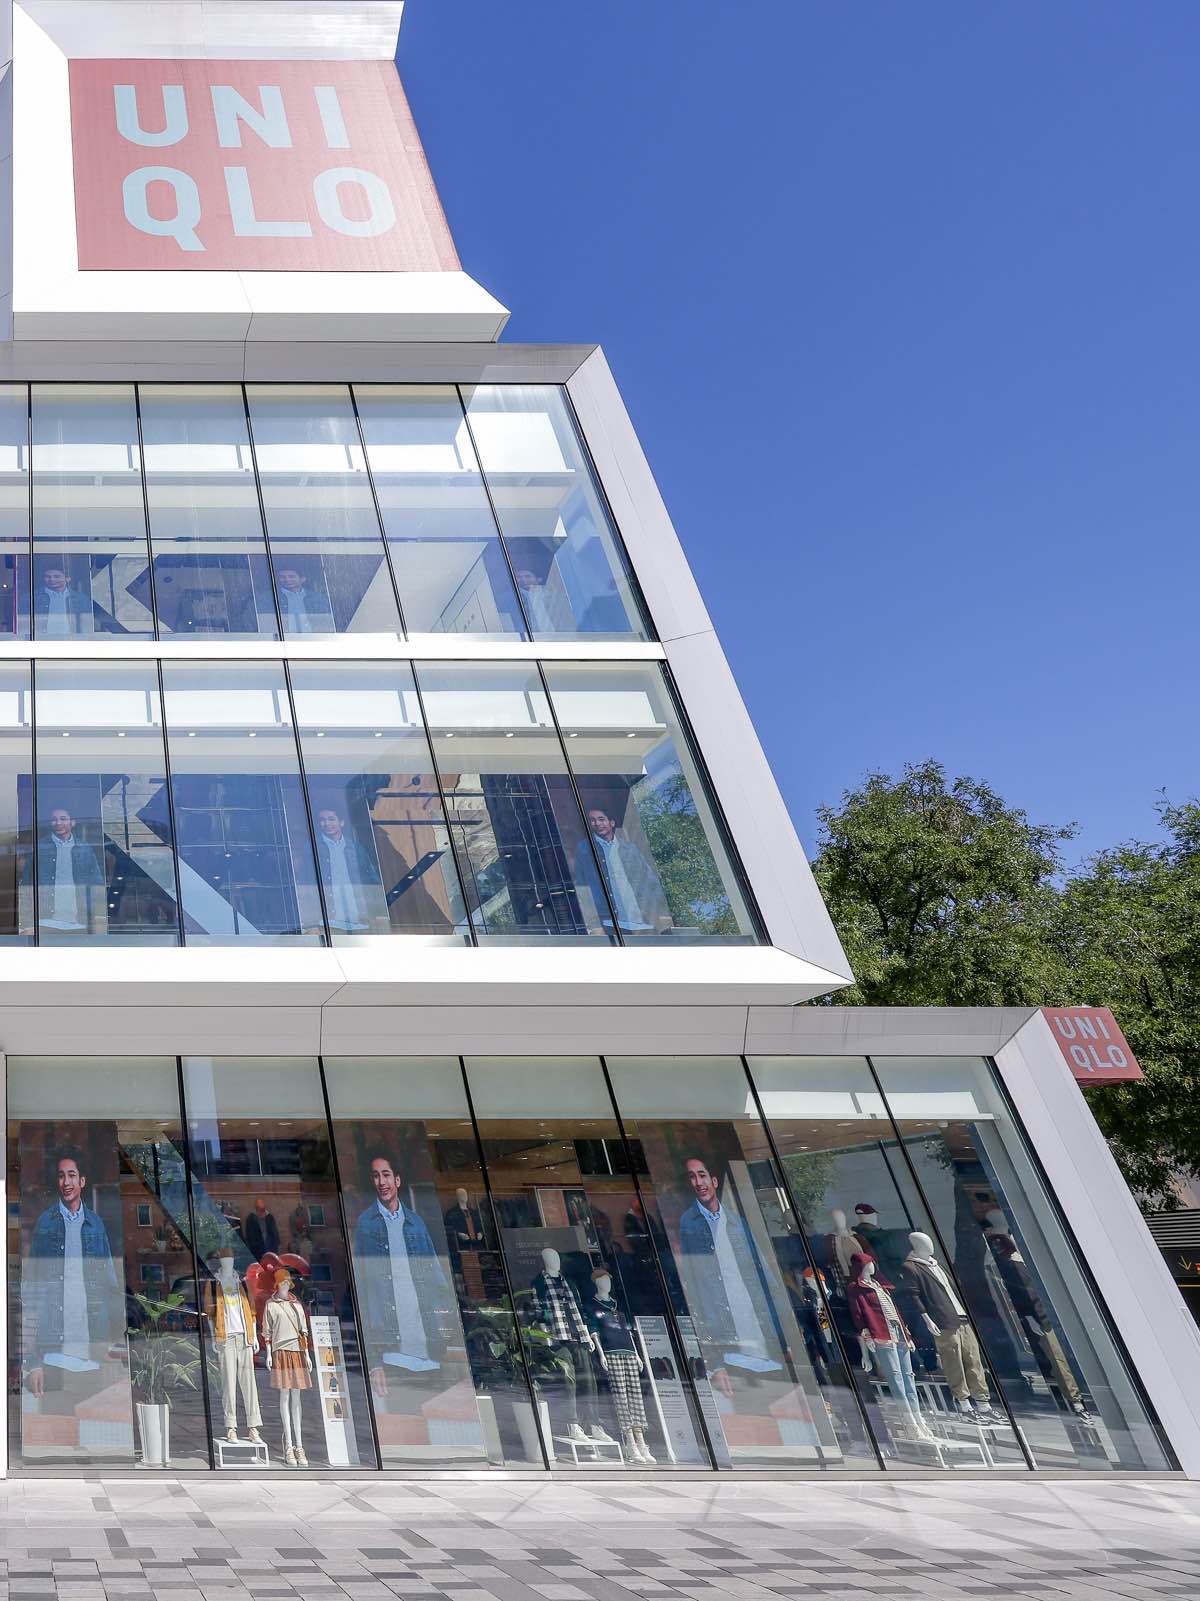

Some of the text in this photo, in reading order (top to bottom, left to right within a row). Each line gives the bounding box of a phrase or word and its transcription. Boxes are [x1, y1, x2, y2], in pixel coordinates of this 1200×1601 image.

[113, 85, 351, 148] UNI
[123, 166, 397, 252] QLO
[1054, 1016, 1110, 1040] UNI
[1070, 1045, 1127, 1072] QLO
